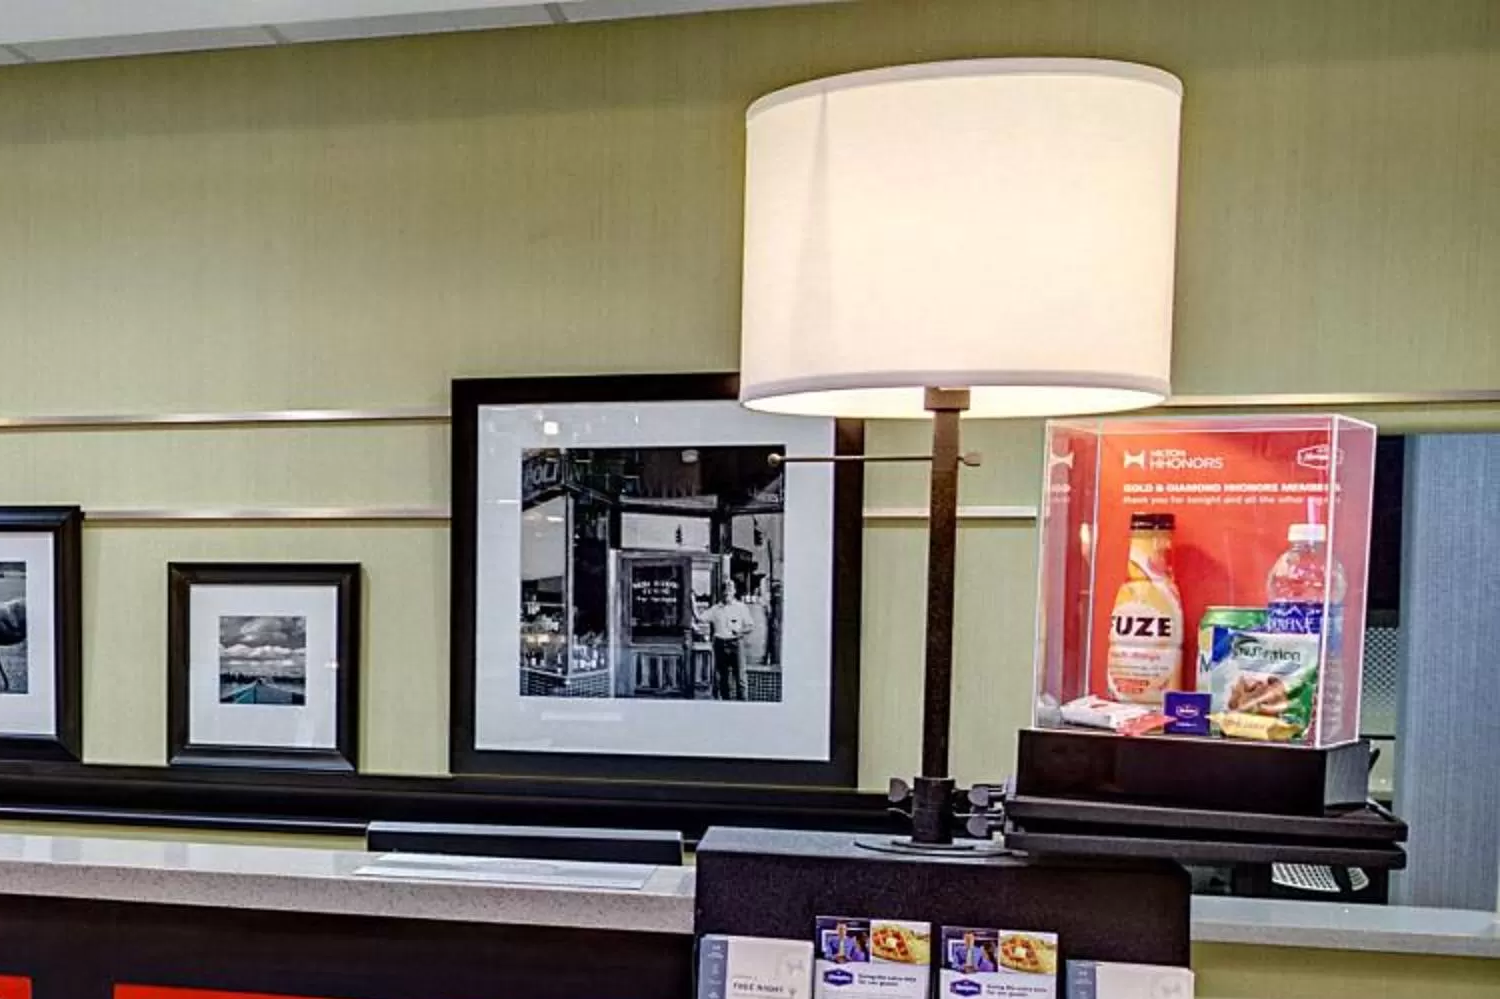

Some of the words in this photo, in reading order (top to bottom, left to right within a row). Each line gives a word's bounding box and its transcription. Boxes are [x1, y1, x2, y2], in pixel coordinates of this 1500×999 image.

[1149, 448, 1187, 457] HILTON
[1149, 456, 1224, 469] HHONORS
[1123, 483, 1153, 493] GOLD
[1166, 483, 1222, 493] DIAMOND
[1224, 483, 1279, 493] HHONORS
